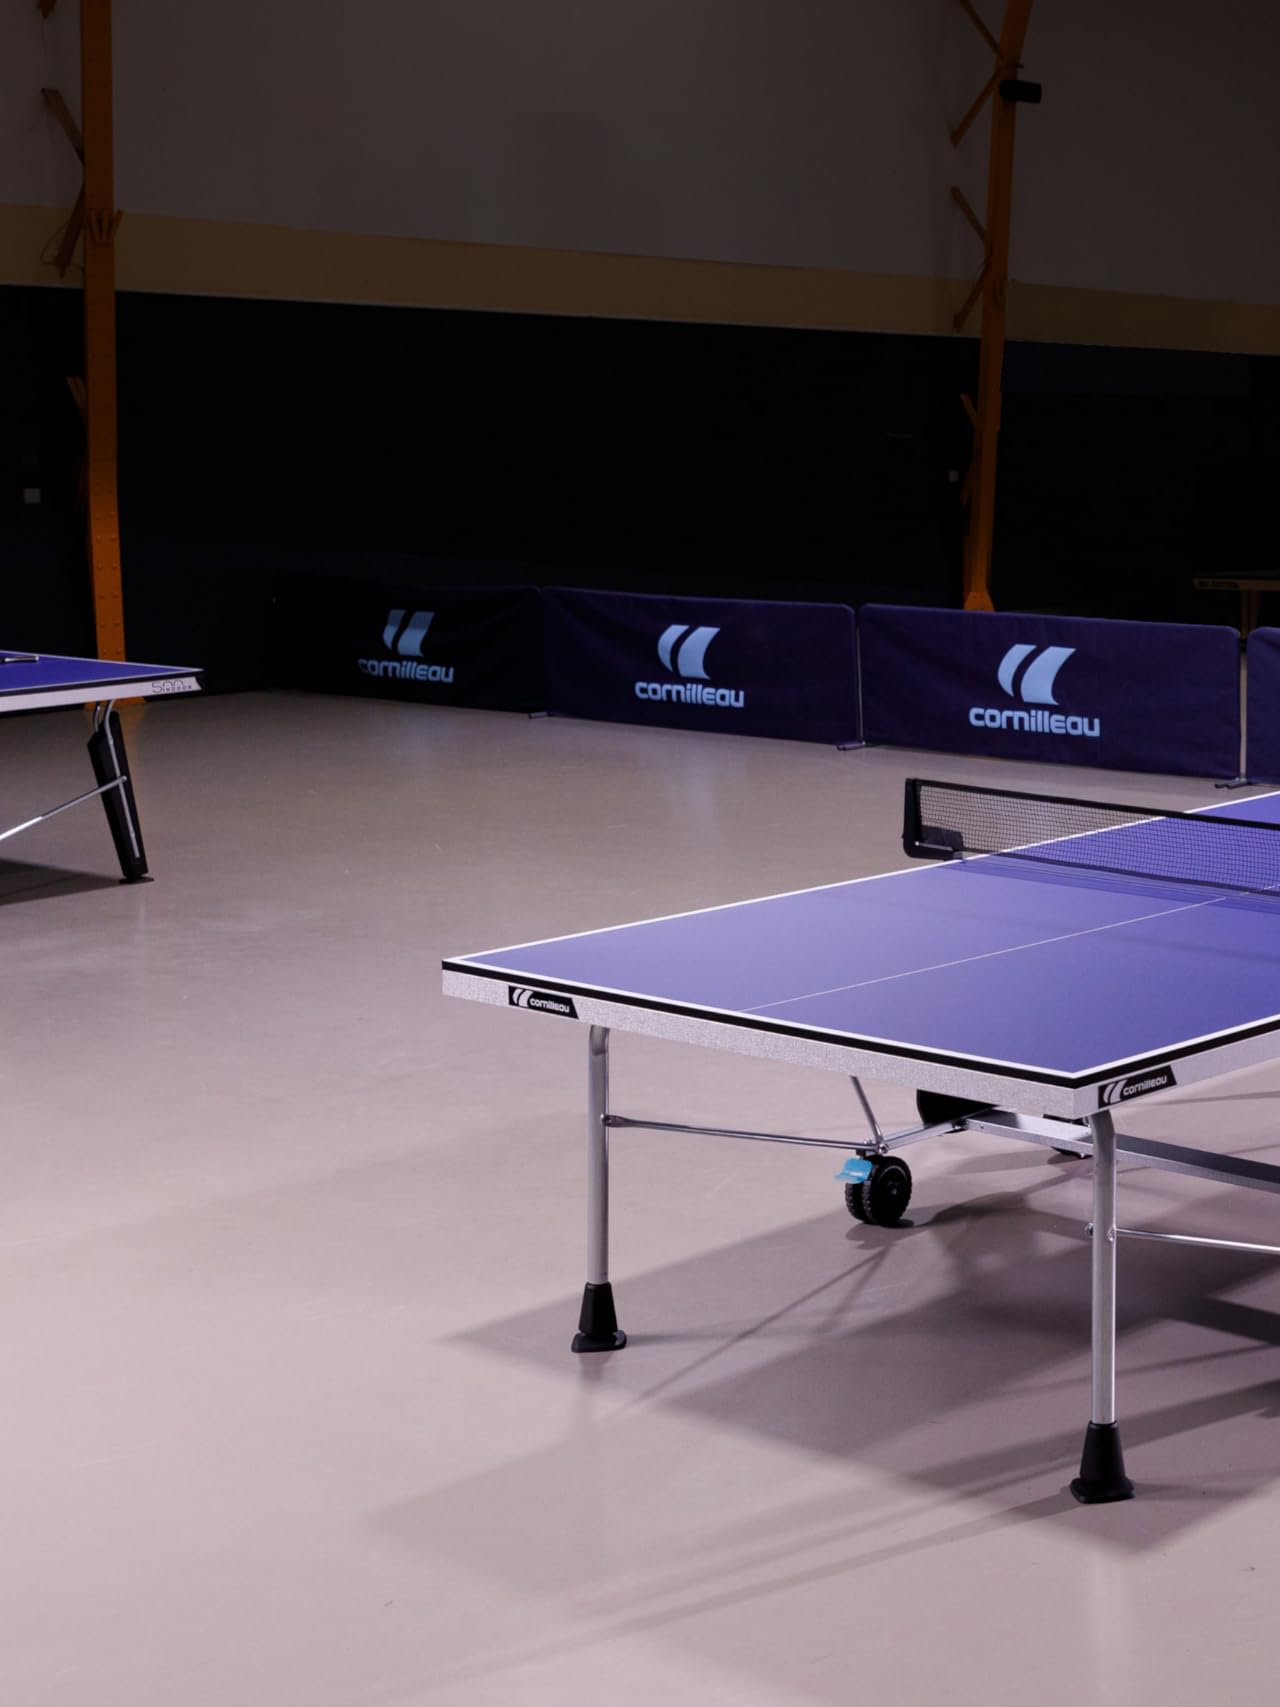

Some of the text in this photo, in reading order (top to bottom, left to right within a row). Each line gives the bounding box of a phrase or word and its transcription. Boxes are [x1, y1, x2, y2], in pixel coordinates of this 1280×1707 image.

[357, 658, 455, 683] cornilleau
[634, 681, 745, 708] cornilleau
[968, 706, 1101, 737] cornilleau
[529, 997, 571, 1014] cornilleau
[1122, 1074, 1169, 1097] cornilleau
